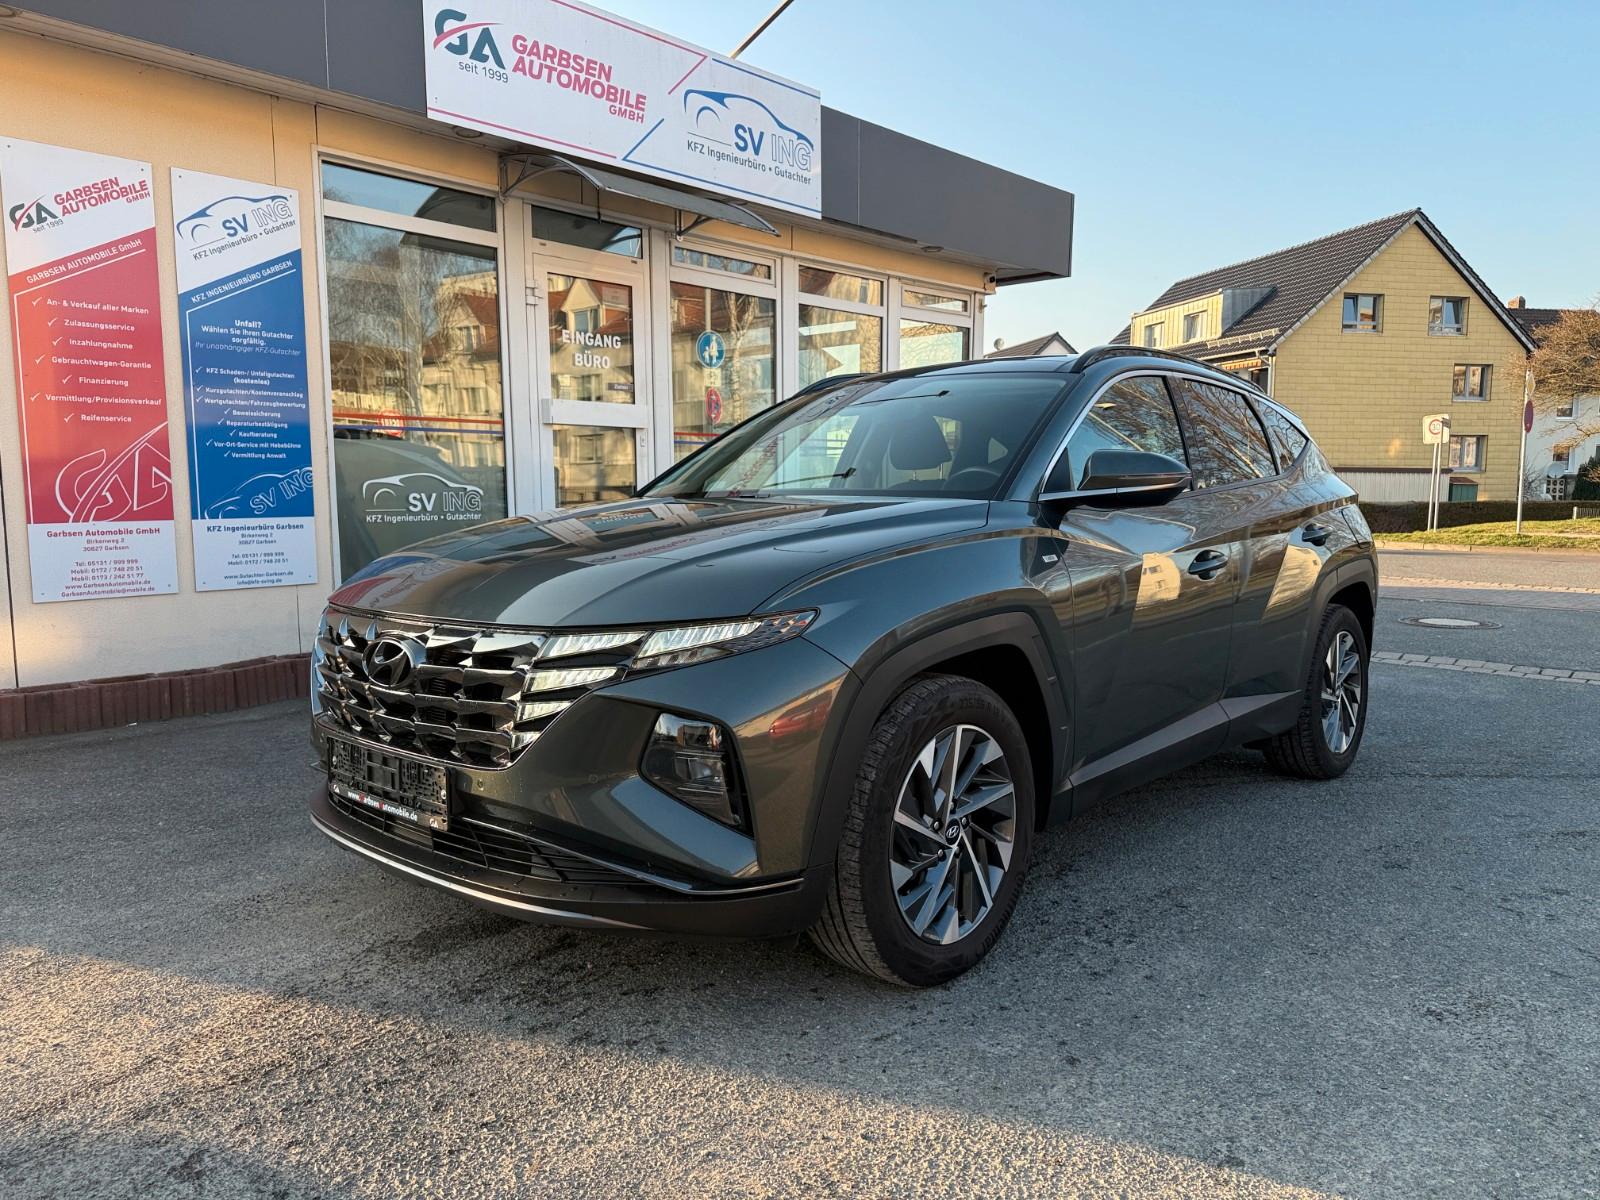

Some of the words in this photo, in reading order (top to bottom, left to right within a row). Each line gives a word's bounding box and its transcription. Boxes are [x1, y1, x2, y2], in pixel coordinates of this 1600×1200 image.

[511, 34, 613, 83] GARBSEN
[458, 61, 478, 74] seit
[482, 67, 509, 84] 1999
[511, 56, 647, 112] AUTOMOBILE
[609, 104, 645, 123] GMBH
[734, 123, 765, 156] SV
[771, 133, 812, 172] ING
[687, 139, 705, 154] KFZ
[707, 146, 766, 172] Ingenieurbüro
[774, 165, 811, 185] Gutachter
[54, 177, 120, 205] GARBSEN
[61, 180, 148, 217] AUTOMOBILE
[126, 191, 151, 204] GMBH
[33, 222, 46, 233] seit
[47, 218, 64, 229] 1999
[222, 213, 249, 238] SV
[251, 200, 293, 227] ING
[192, 250, 209, 261] KFZ
[209, 232, 258, 256] Ingenieurbüro
[264, 219, 296, 236] Gutachter
[26, 264, 67, 284] GARBSEN
[67, 246, 118, 271] AUTOMOBILE
[118, 238, 142, 253] GmbH
[191, 292, 207, 304] KFZ
[206, 272, 261, 298] INGENIEURBÜRO
[262, 259, 293, 277] GARBSEN
[62, 299, 69, 307] &
[70, 300, 101, 310] Verkauf
[102, 302, 119, 311] aller
[121, 305, 149, 315] Marken
[64, 318, 136, 332] Zulassungsservice
[201, 325, 229, 334] Wählen
[261, 331, 294, 340] Gutachter
[234, 320, 262, 328] Unfall?
[69, 338, 134, 350] Inzahlungnahme
[561, 329, 621, 349] EINGANG
[51, 356, 152, 369] Gebrauchtwagen-Garantie
[574, 351, 611, 369] BÜRO
[79, 376, 129, 387] Finanzierung
[45, 394, 162, 406] Vermittlung/Provisionsverkauf
[81, 414, 132, 423] Reifenservice
[249, 487, 277, 514] SV
[408, 492, 437, 512] SV
[442, 490, 481, 511] ING
[366, 514, 383, 523] KFZ
[384, 513, 439, 523] Ingenieurbüro
[446, 512, 481, 521] Gutachter
[47, 530, 83, 538] Garbsen
[85, 528, 134, 537] Automobile
[136, 527, 161, 535] GmbH
[224, 524, 274, 533] Ingenieurbüro
[276, 523, 304, 531] Garbsen
